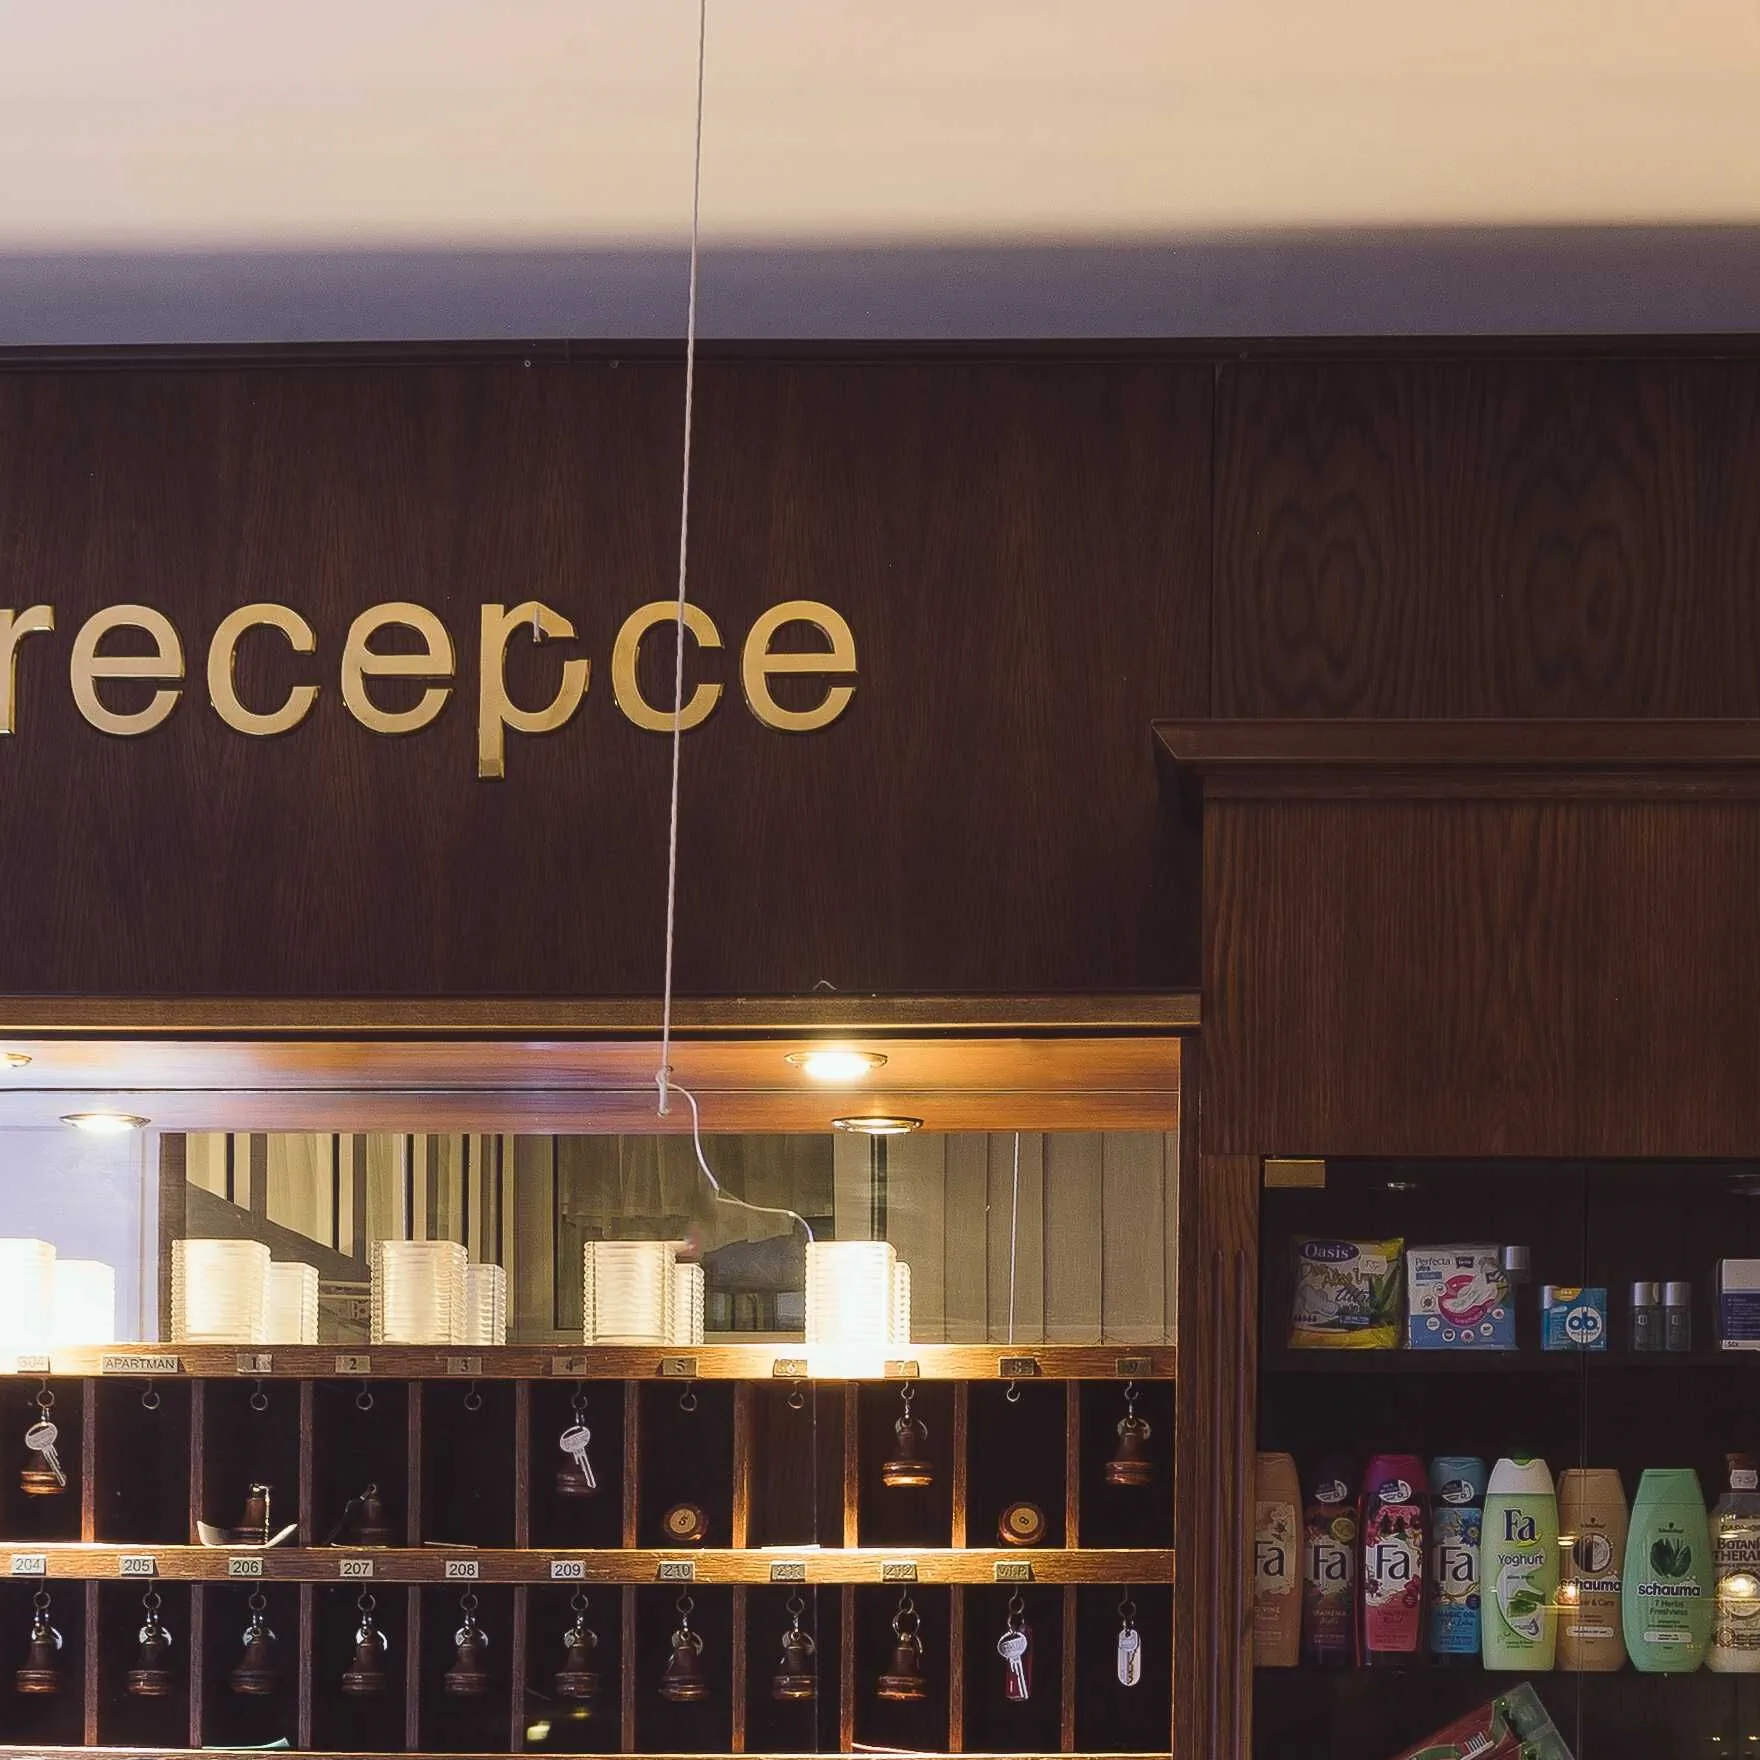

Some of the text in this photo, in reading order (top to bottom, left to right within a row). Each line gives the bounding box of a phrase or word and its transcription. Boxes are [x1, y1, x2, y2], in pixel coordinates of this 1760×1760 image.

[1304, 1243, 1351, 1260] Oasis
[1415, 1255, 1451, 1267] Perfecta
[104, 1358, 175, 1370] APARTMAN
[1503, 1509, 1537, 1542] Fa
[15, 1558, 42, 1571] 204
[124, 1559, 150, 1572] 205
[233, 1560, 259, 1574] 206
[1313, 1545, 1347, 1581] Fa
[1375, 1545, 1410, 1580] Fa
[1441, 1547, 1474, 1581] Fa
[1498, 1553, 1545, 1568] Yoghurt
[343, 1562, 369, 1576] 207
[449, 1563, 475, 1577] 208
[554, 1564, 581, 1577] 209
[663, 1564, 690, 1577] 210
[885, 1565, 912, 1577] 212
[1638, 1583, 1702, 1598] schauma
